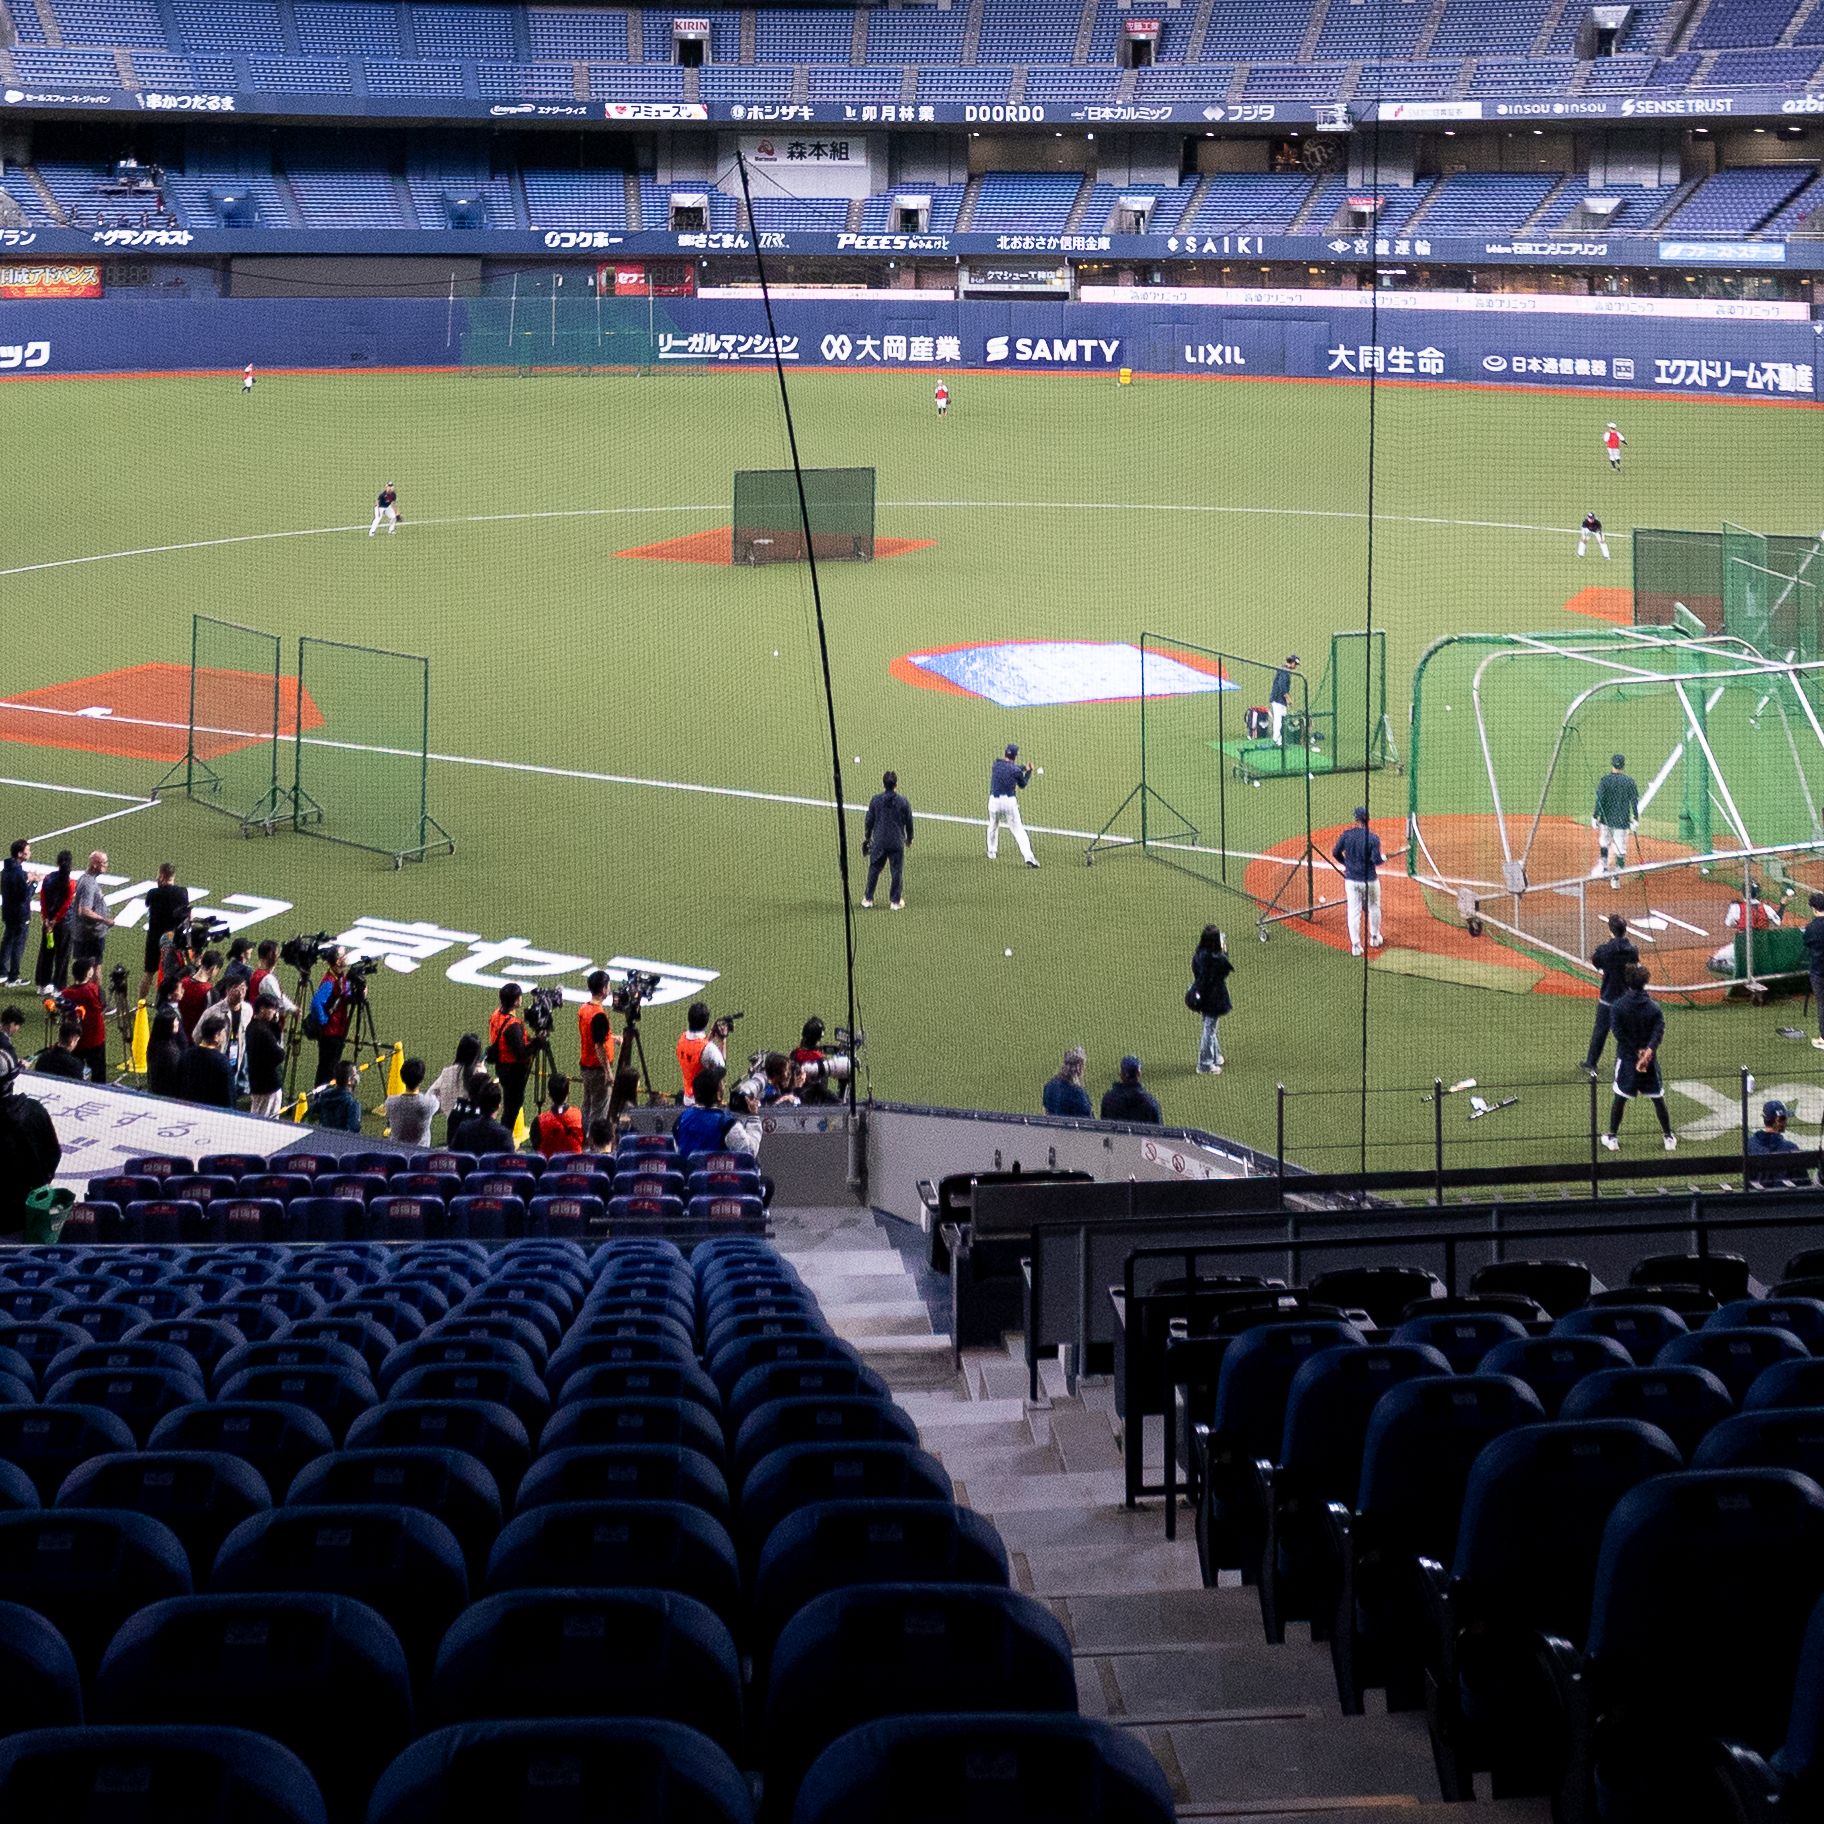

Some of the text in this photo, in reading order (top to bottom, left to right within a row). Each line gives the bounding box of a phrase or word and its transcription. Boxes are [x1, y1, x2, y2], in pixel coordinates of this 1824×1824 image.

[674, 20, 709, 32] KIRIN
[146, 93, 235, 112] 串かつだるま
[628, 104, 684, 119] アミューズ
[746, 105, 814, 121] ホシザキ
[861, 106, 935, 122] 卯月林業
[965, 106, 1045, 122] DOORDO
[1087, 105, 1173, 120] 日本カルミック
[1227, 105, 1275, 121] フジタ
[786, 140, 851, 162] 森本組
[996, 236, 1111, 251] 北おおさか信用金庫
[1184, 237, 1264, 254] SAIKI
[658, 333, 799, 357] リーガルマンション
[855, 334, 961, 362] 大岡産業
[1015, 338, 1120, 362] SAMTY
[1184, 344, 1246, 365] LIXIL
[1327, 345, 1446, 376] 大同生命
[1654, 359, 1814, 394] エクスドリーム不動産
